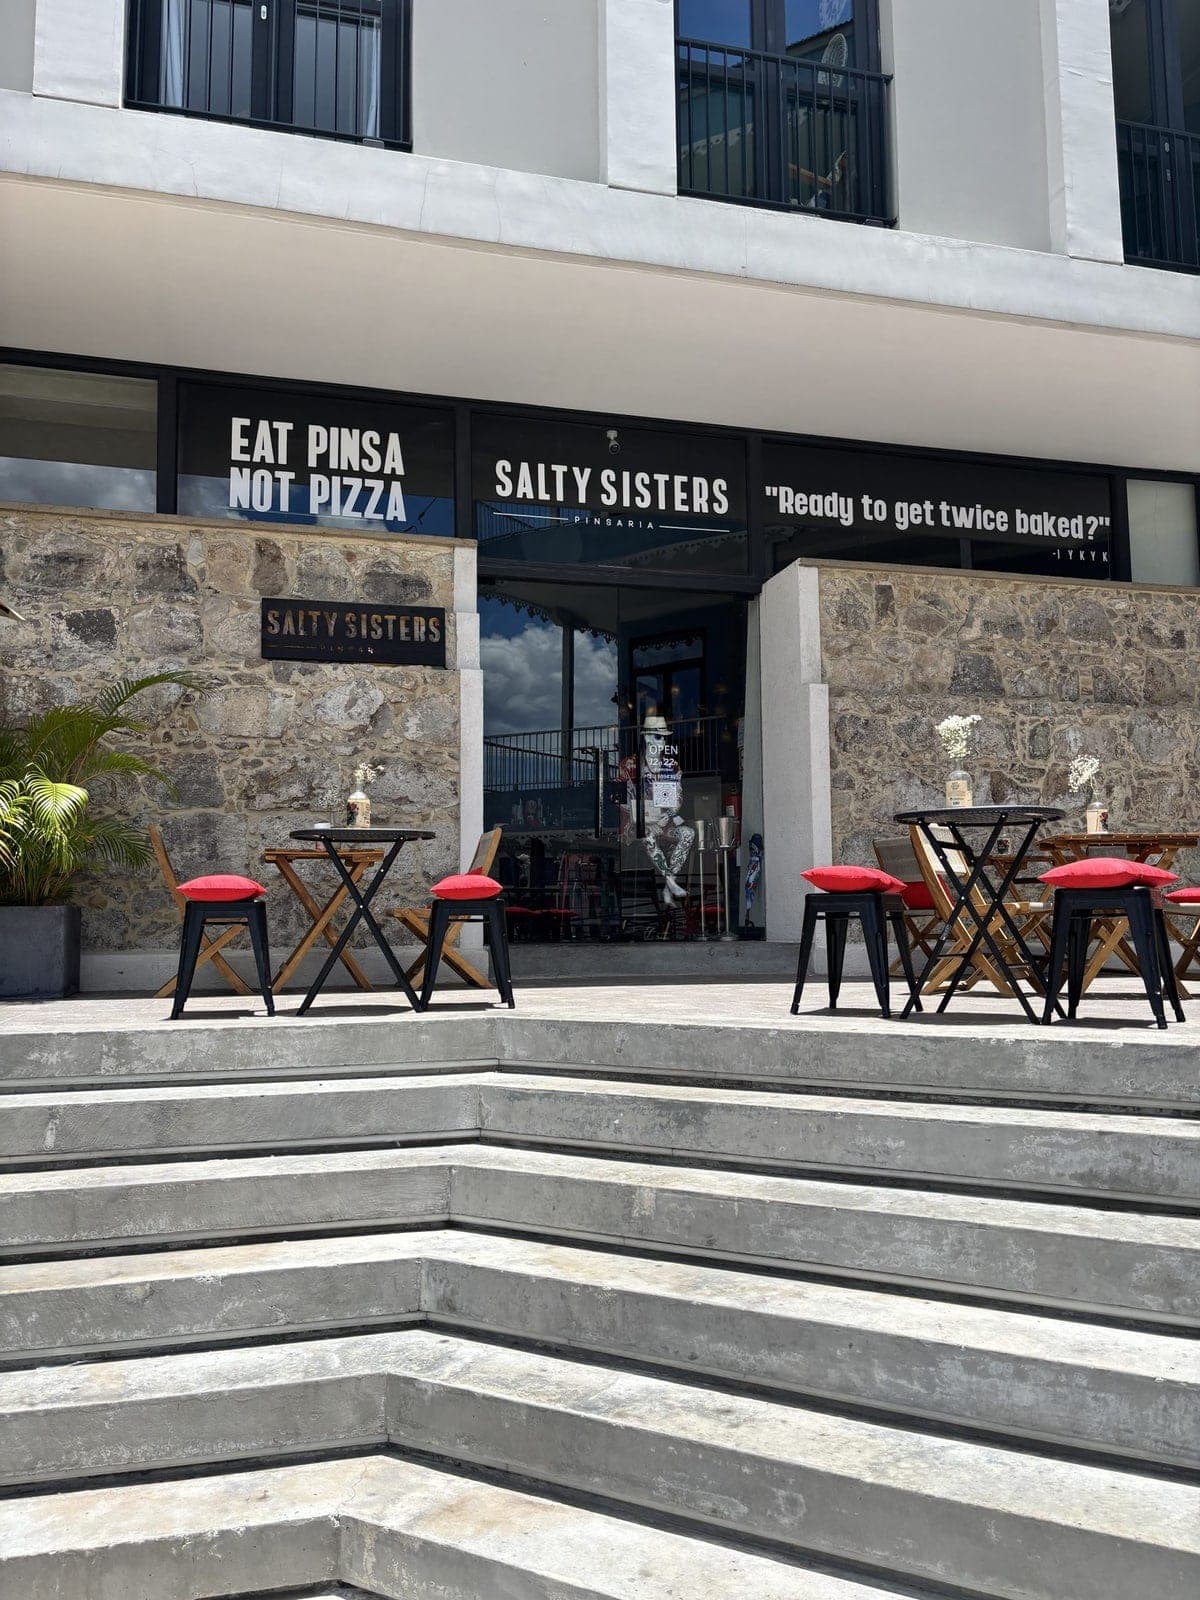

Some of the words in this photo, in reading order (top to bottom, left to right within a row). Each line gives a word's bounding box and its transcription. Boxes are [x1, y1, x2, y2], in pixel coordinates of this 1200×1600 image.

[230, 417, 294, 465] EAT
[307, 424, 406, 476] PINSA
[229, 466, 296, 513] NOT
[309, 473, 407, 522] PIZZA
[495, 459, 592, 504] SALTY
[600, 468, 729, 515] SISTERS
[764, 486, 854, 526] "Ready
[861, 494, 887, 522] to
[894, 499, 935, 531] get
[939, 501, 1009, 532] twice
[1015, 508, 1111, 541] baked?"
[574, 515, 654, 530] PINSARIA
[266, 609, 338, 637] SALTY
[344, 612, 442, 643] SISTERS
[649, 744, 678, 755] OPEN
